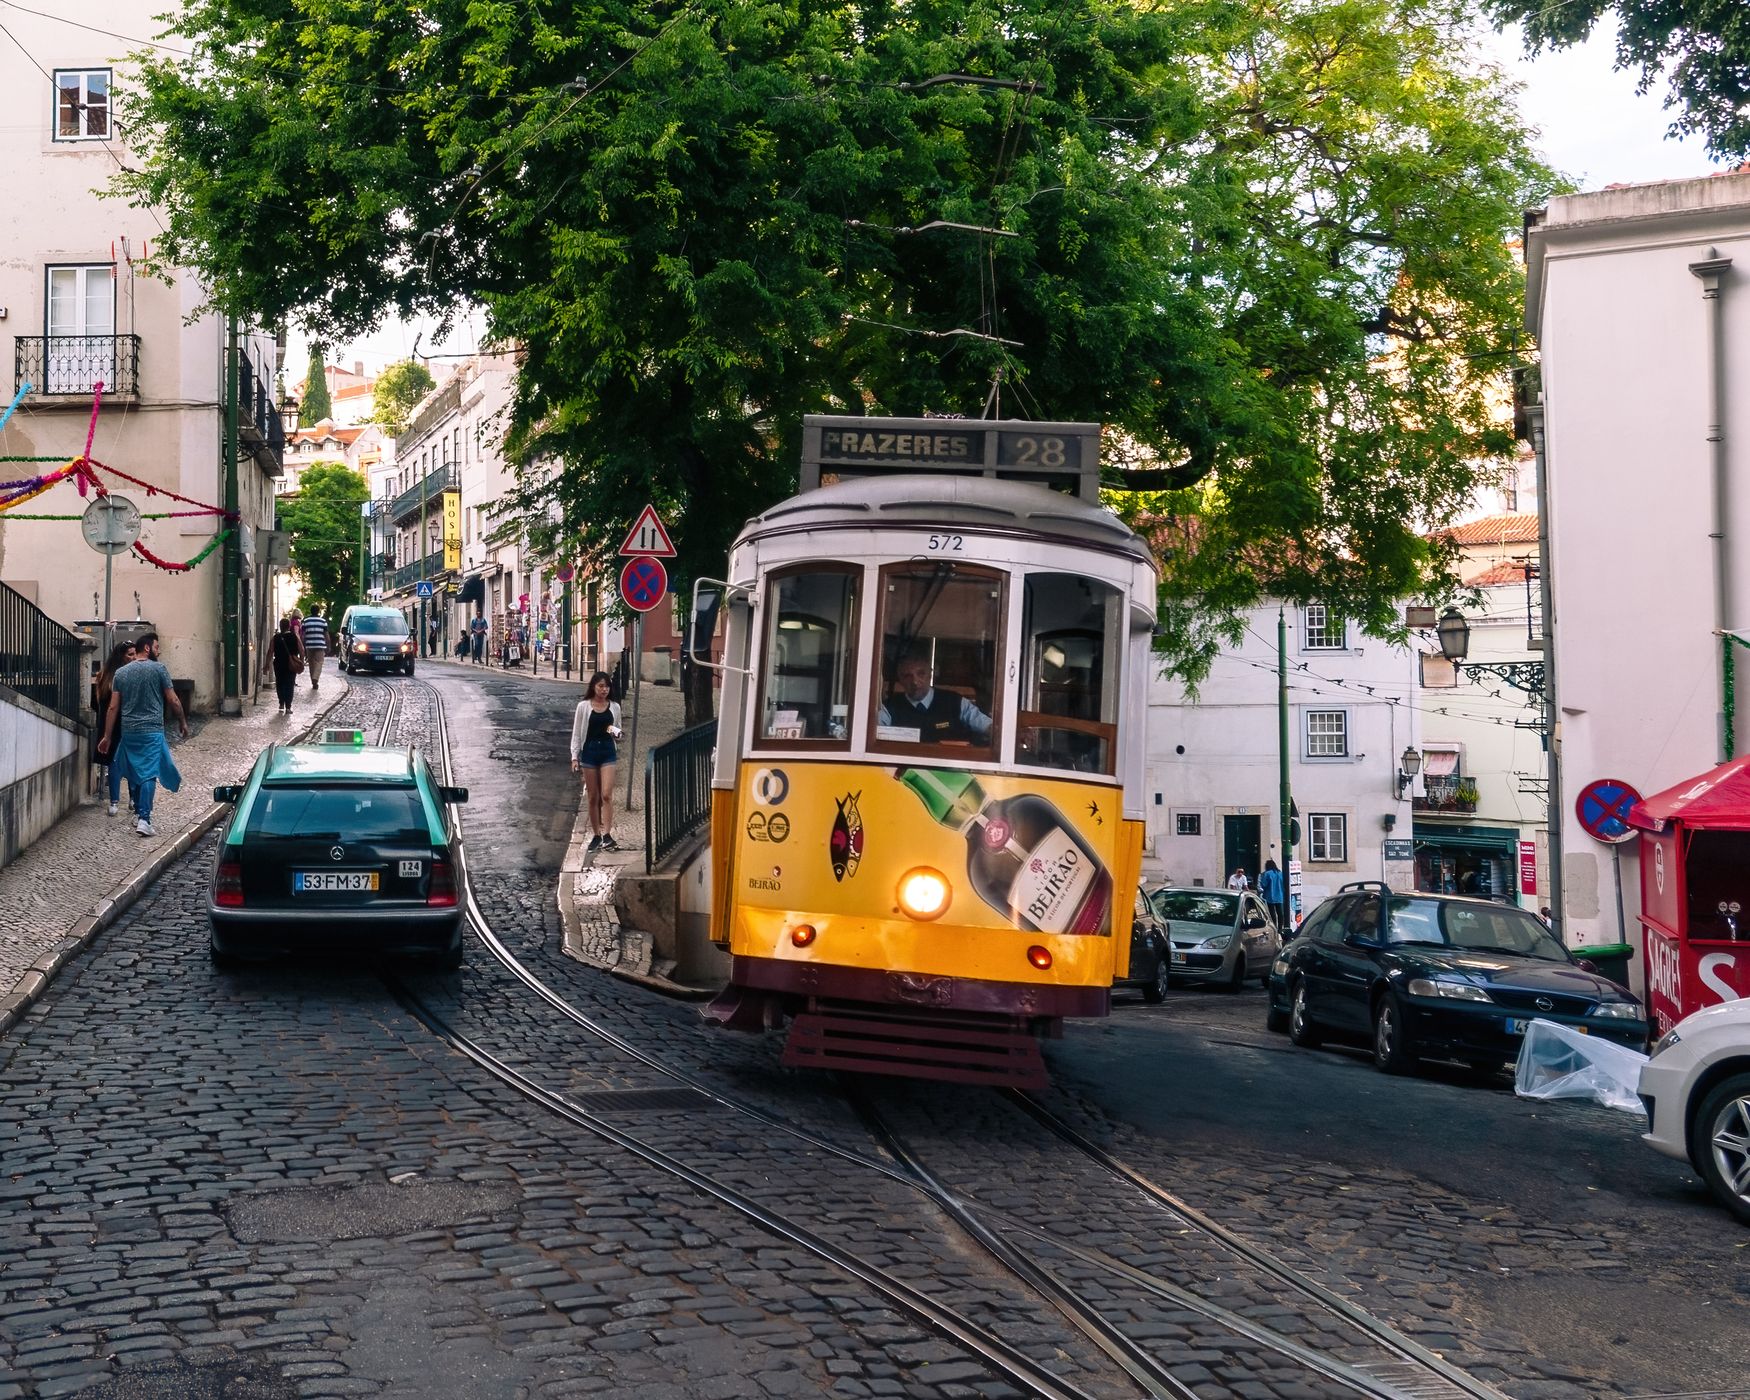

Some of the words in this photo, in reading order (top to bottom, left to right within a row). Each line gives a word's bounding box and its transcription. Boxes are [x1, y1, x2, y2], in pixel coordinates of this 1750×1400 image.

[825, 432, 968, 456] PRAZERES
[1016, 437, 1065, 467] 28
[928, 536, 962, 551] 572
[402, 862, 419, 871] 124
[1027, 849, 1078, 921] BEIRÃO
